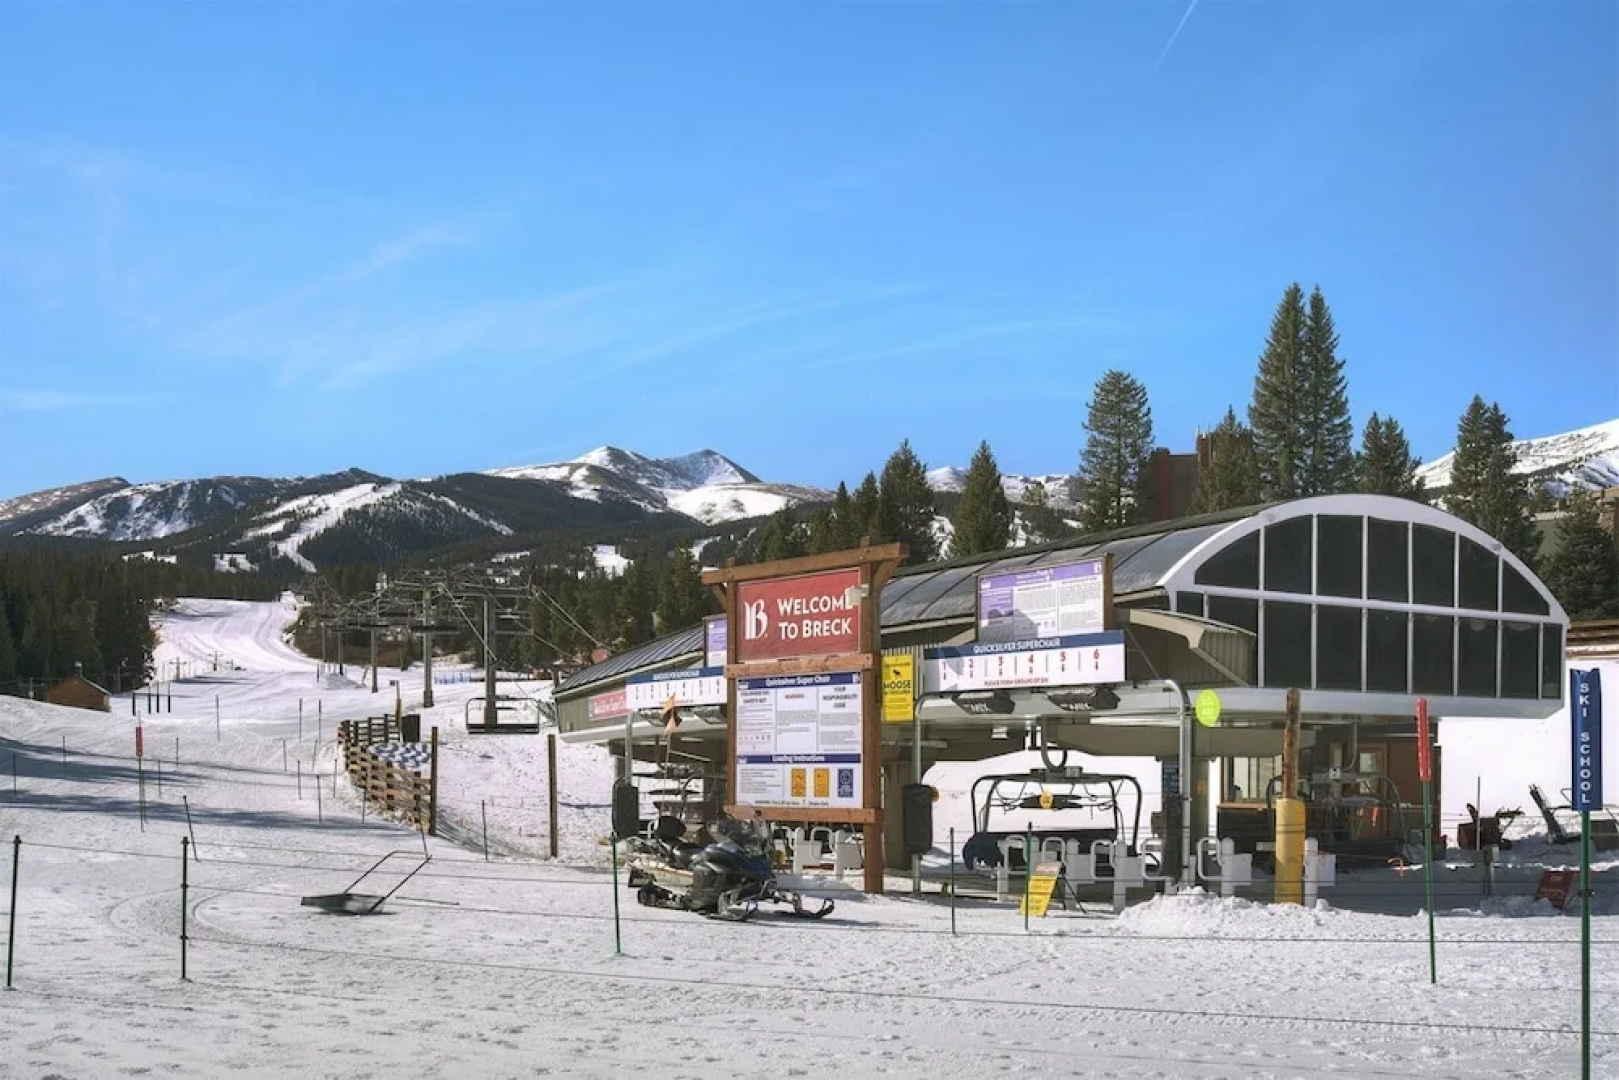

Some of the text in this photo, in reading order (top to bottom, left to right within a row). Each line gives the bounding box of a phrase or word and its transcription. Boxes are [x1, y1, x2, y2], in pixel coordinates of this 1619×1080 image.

[779, 618, 852, 640] TO BRECK
[973, 639, 1061, 653] QUICKSILVER SUPERCHAIR
[765, 674, 830, 687] Quicksilver Super Chair
[883, 680, 911, 690] MOOSE
[1580, 683, 1591, 803] SKI SCHOOL
